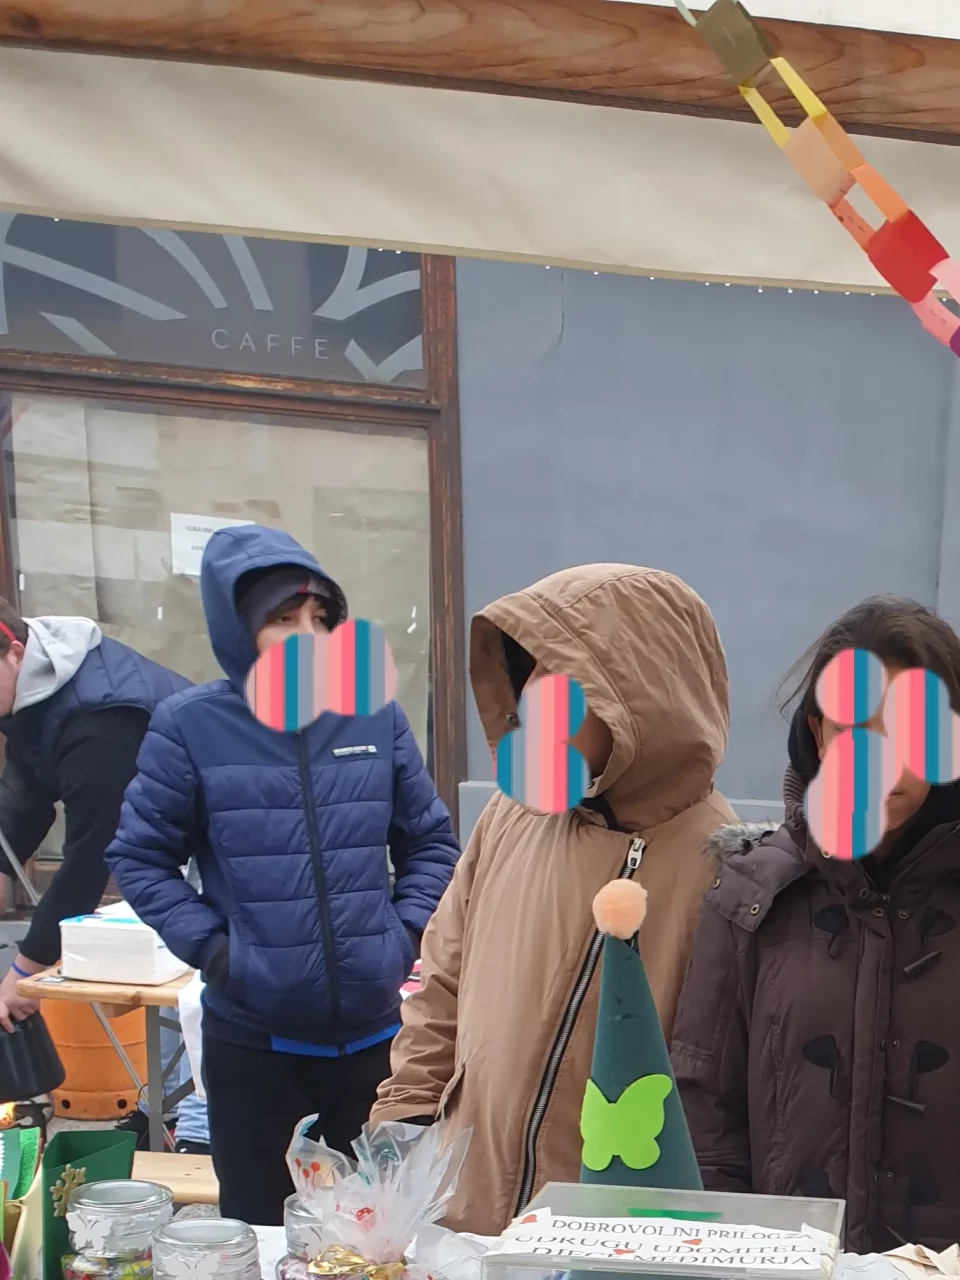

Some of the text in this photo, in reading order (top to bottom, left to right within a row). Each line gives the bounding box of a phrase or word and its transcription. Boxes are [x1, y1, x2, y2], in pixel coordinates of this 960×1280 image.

[211, 328, 329, 360] CAFFE
[551, 1219, 700, 1238] DOBROVOLJNI
[707, 1228, 781, 1240] PRILOG
